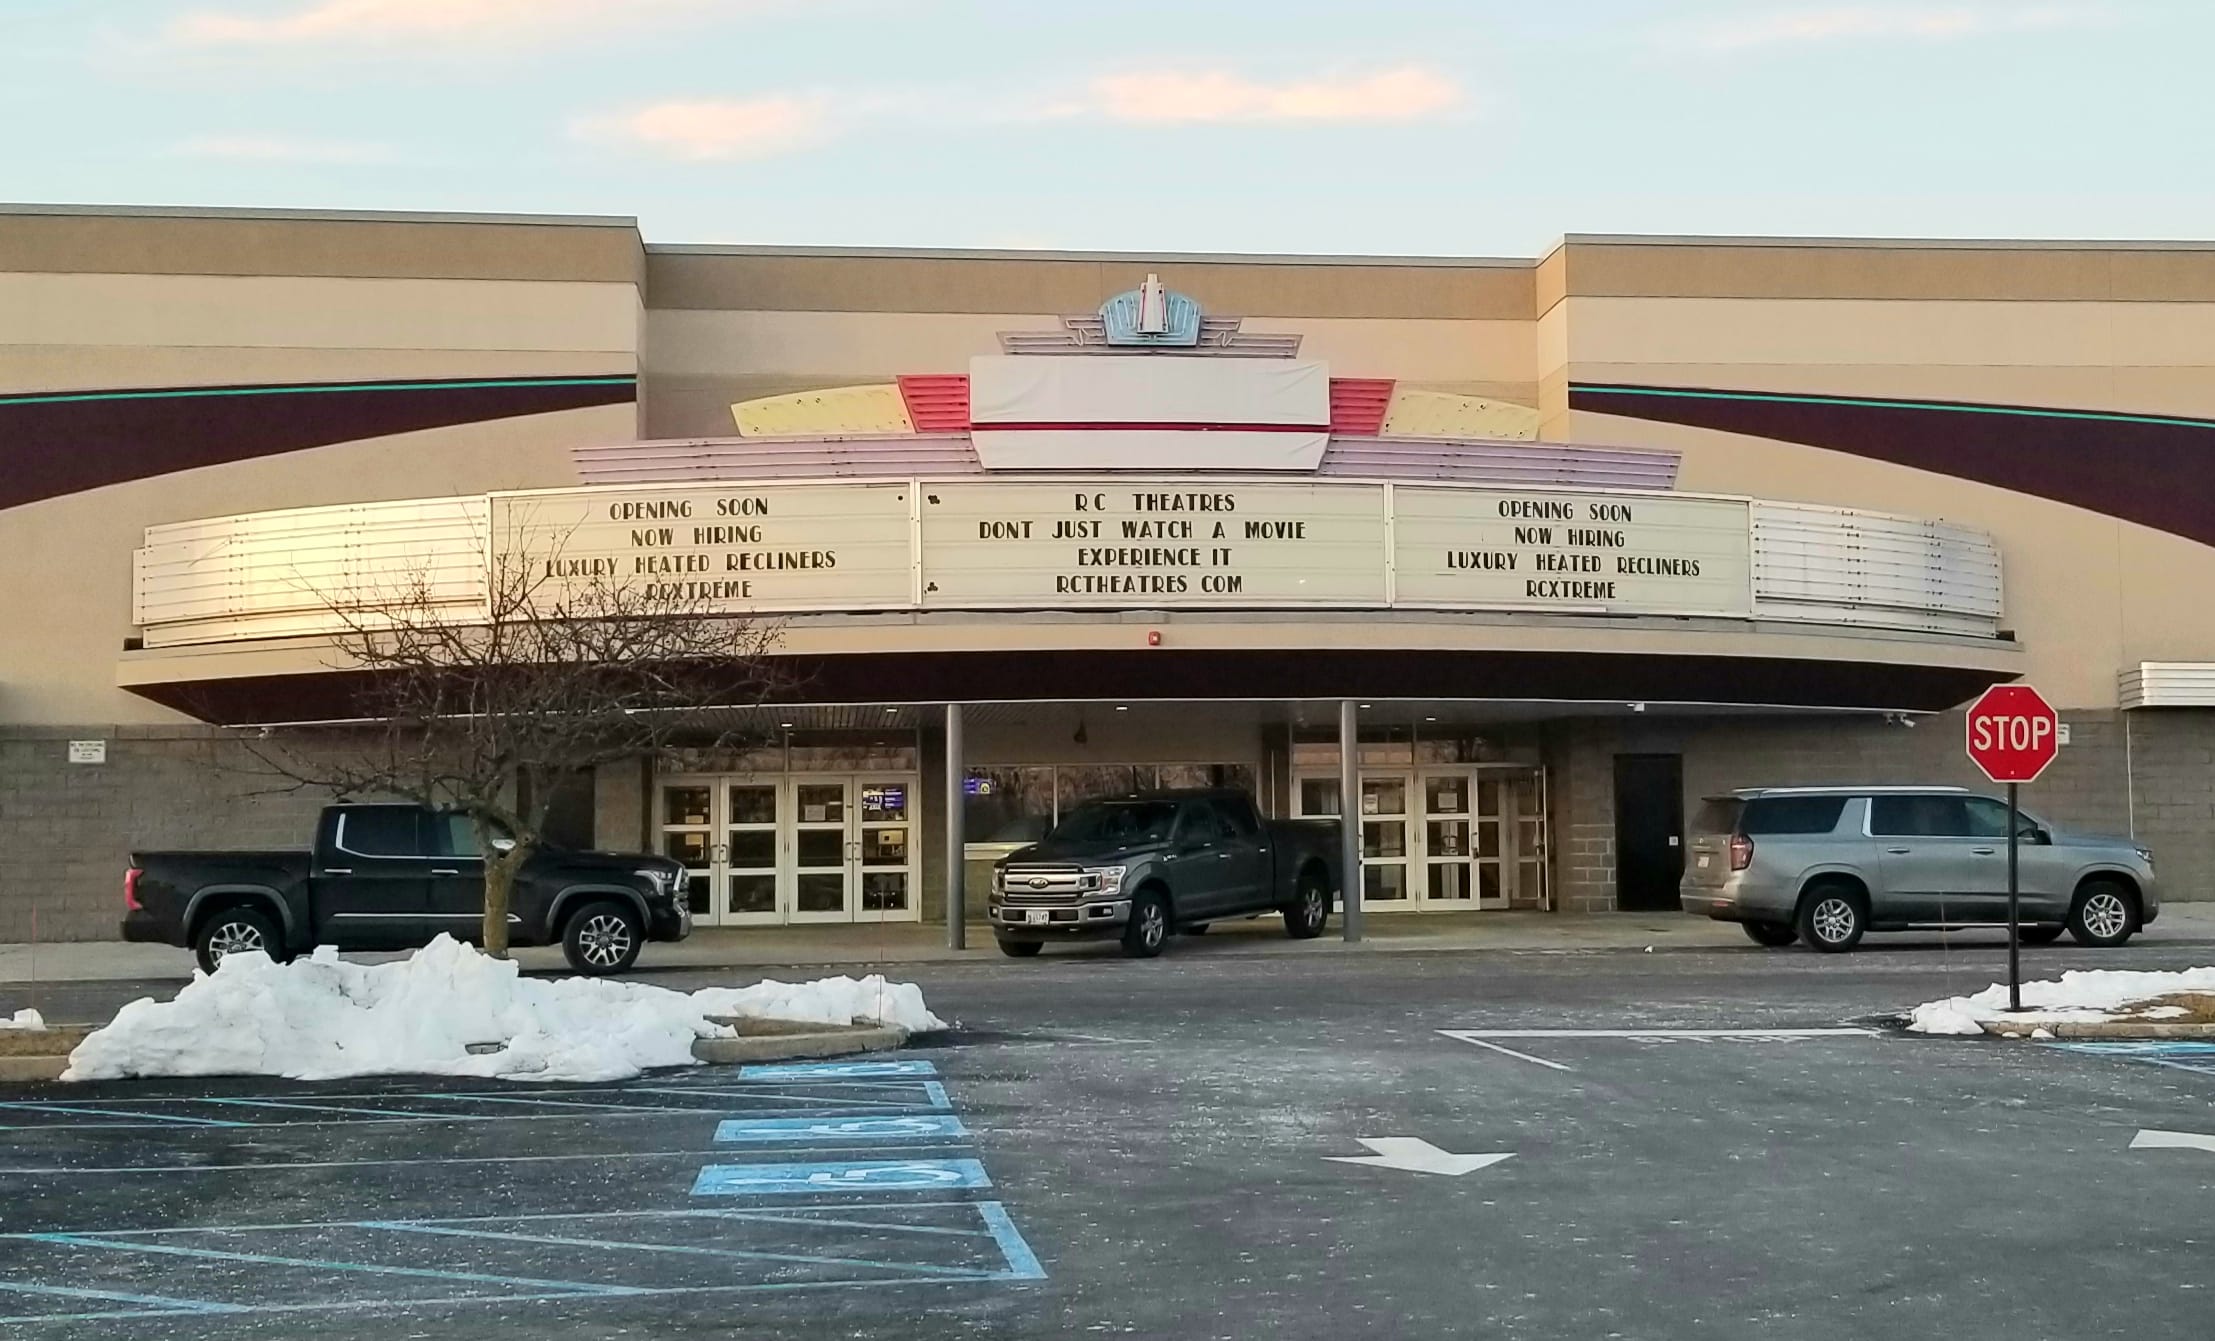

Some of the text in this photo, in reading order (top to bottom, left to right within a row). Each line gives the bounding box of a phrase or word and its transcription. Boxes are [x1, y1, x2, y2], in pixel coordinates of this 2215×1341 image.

[609, 497, 768, 520] OPENING SOON
[1132, 493, 1235, 512] THEATRES
[1498, 500, 1632, 522] OPENING SOON
[631, 525, 762, 547] NOW HIRING
[979, 520, 1306, 539] DONT JUST WATCH A MOVIE
[1514, 526, 1625, 548] NOW HIRING
[546, 550, 836, 578] LUXURY HEATED RECLINERS
[1078, 547, 1232, 566] EXPERIENCE IT
[1447, 551, 1700, 577] LUXURY HEATED RECLINERS
[1056, 574, 1243, 593] RCTHEATRES COM
[1526, 580, 1616, 599] RCXTREME
[1974, 715, 2051, 751] STOP
